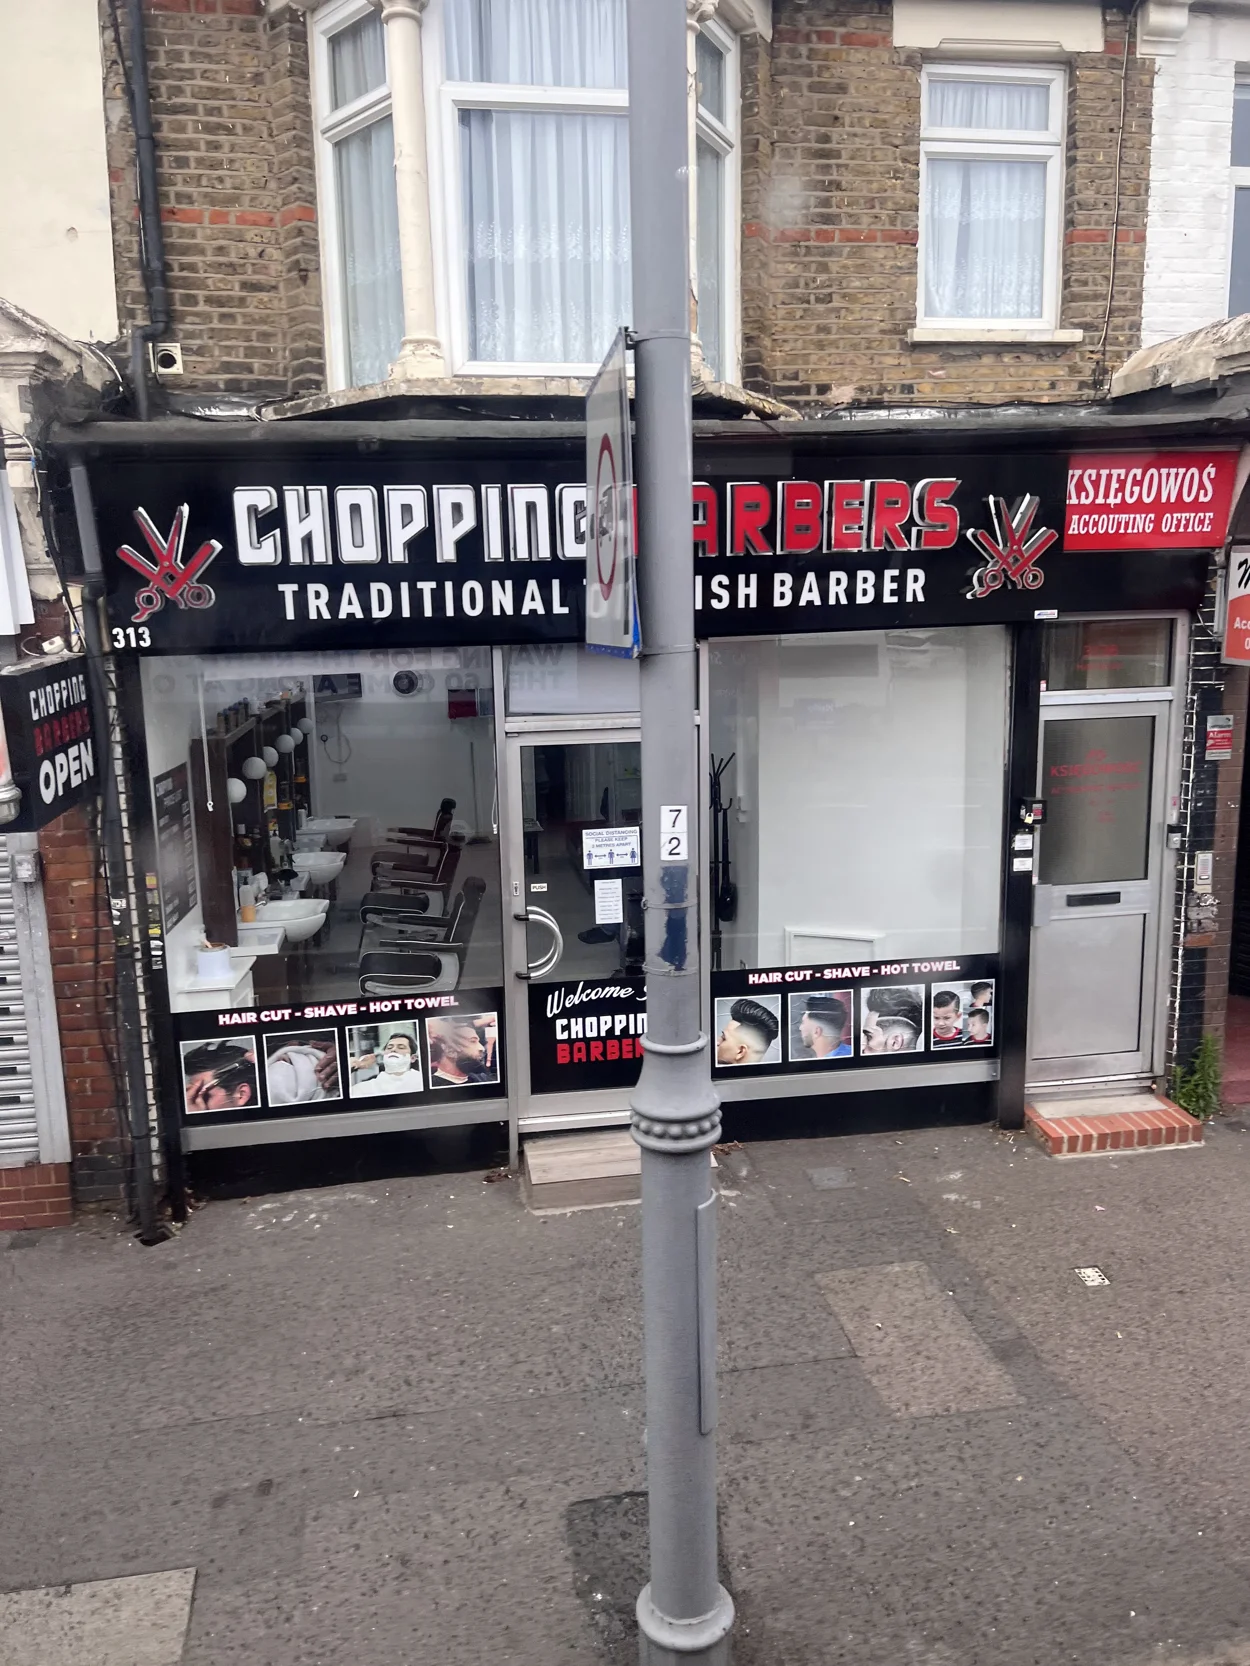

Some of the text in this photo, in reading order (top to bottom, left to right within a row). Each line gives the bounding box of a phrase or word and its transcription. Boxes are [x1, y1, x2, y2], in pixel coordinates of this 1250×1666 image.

[632, 478, 962, 558] ARBERS
[1068, 512, 1214, 535] ACCOUTING OFFICE
[277, 579, 570, 620] TRADITIONAL
[773, 568, 926, 608] BARBER
[112, 627, 152, 649] 313
[29, 674, 87, 721] CHOPPING
[40, 738, 95, 804] OPEN
[668, 809, 682, 829] 7
[668, 837, 682, 856] 2
[748, 972, 783, 985] HAIR
[785, 970, 813, 982] CUT
[823, 966, 870, 980] SHAVE
[881, 963, 909, 976] HOT
[912, 960, 961, 974] TOWEL
[218, 1012, 258, 1026] HAIR
[260, 1009, 292, 1022] CUT
[304, 1003, 358, 1019] SHAVE
[369, 1000, 402, 1013] HOT
[404, 996, 459, 1010] TOWEL
[546, 981, 635, 1018] Welcome
